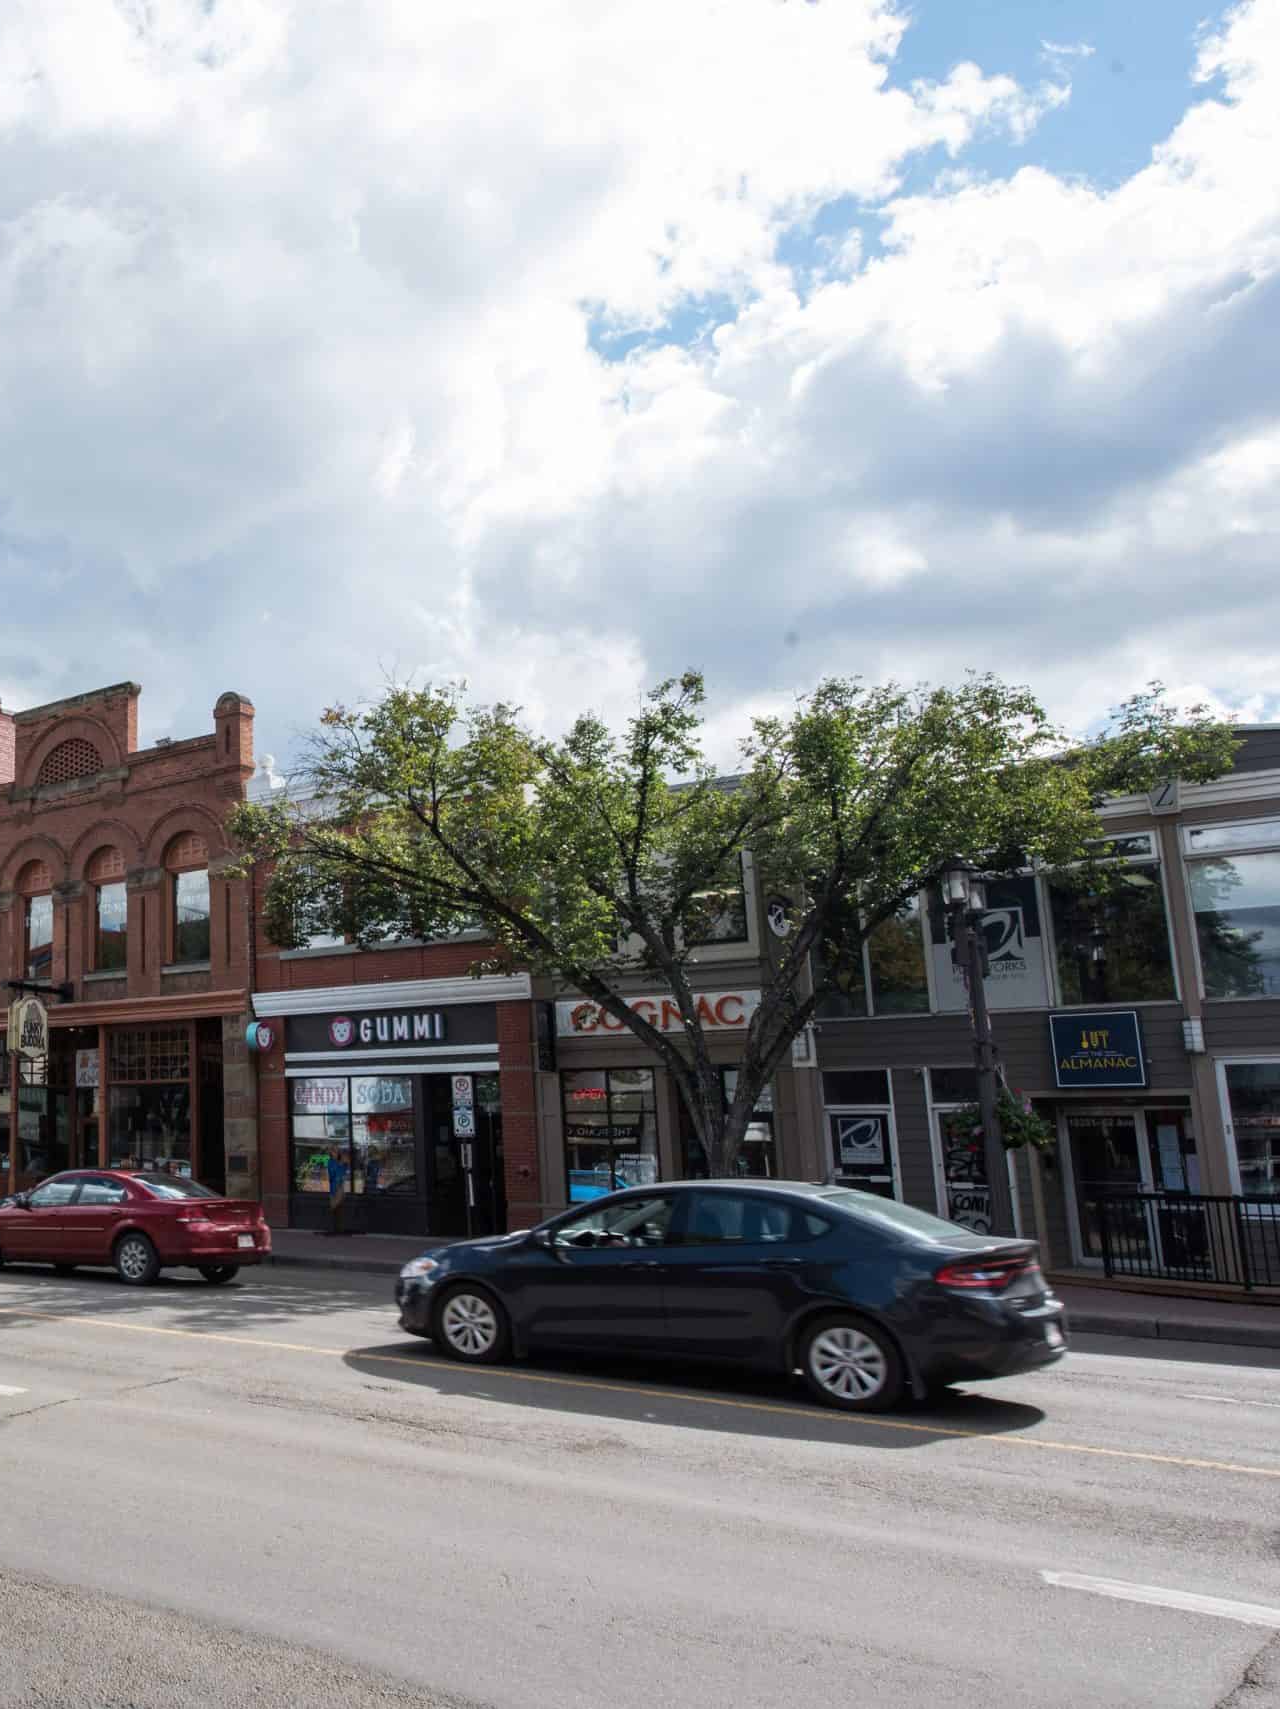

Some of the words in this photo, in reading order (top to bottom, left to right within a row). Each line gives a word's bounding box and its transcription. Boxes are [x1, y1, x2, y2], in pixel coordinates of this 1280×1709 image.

[360, 1013, 443, 1042] GUMMI
[1060, 1056, 1137, 1070] ALMANAC
[295, 1087, 344, 1105] CANDY
[356, 1080, 406, 1105] SODA
